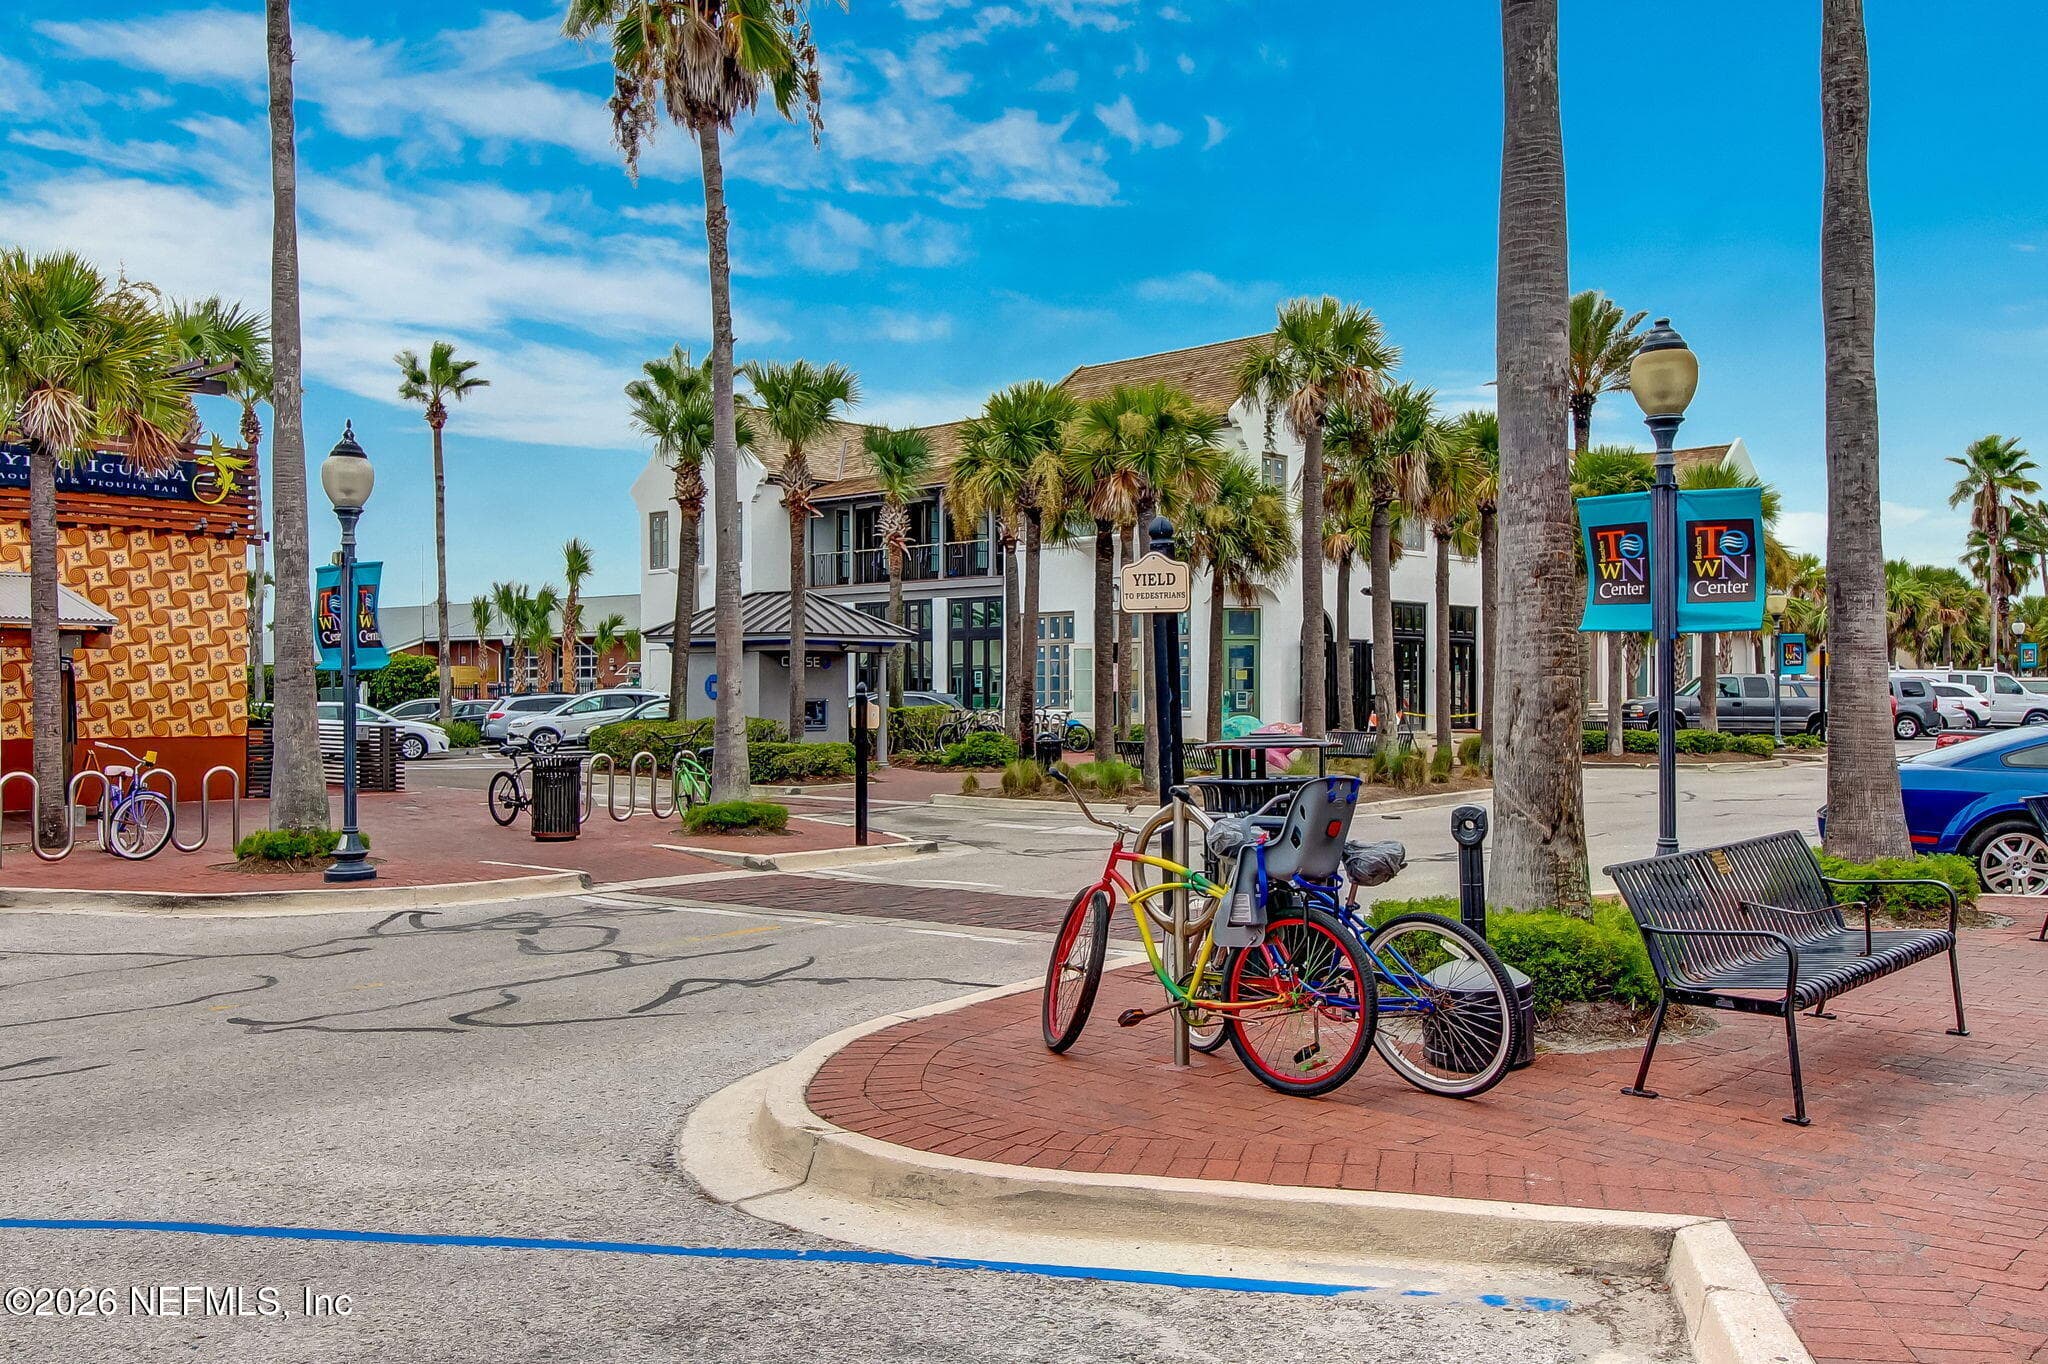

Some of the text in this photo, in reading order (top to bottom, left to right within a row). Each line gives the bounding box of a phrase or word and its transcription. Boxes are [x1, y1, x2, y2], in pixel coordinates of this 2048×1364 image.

[88, 459, 188, 482] IGUANA
[154, 484, 178, 493] BAR
[1133, 573, 1176, 586] YIELD
[1599, 582, 1645, 598] Center
[1693, 580, 1749, 597] Center
[1125, 591, 1185, 600] TO PEDESTRIANS
[781, 656, 820, 667] CSE
